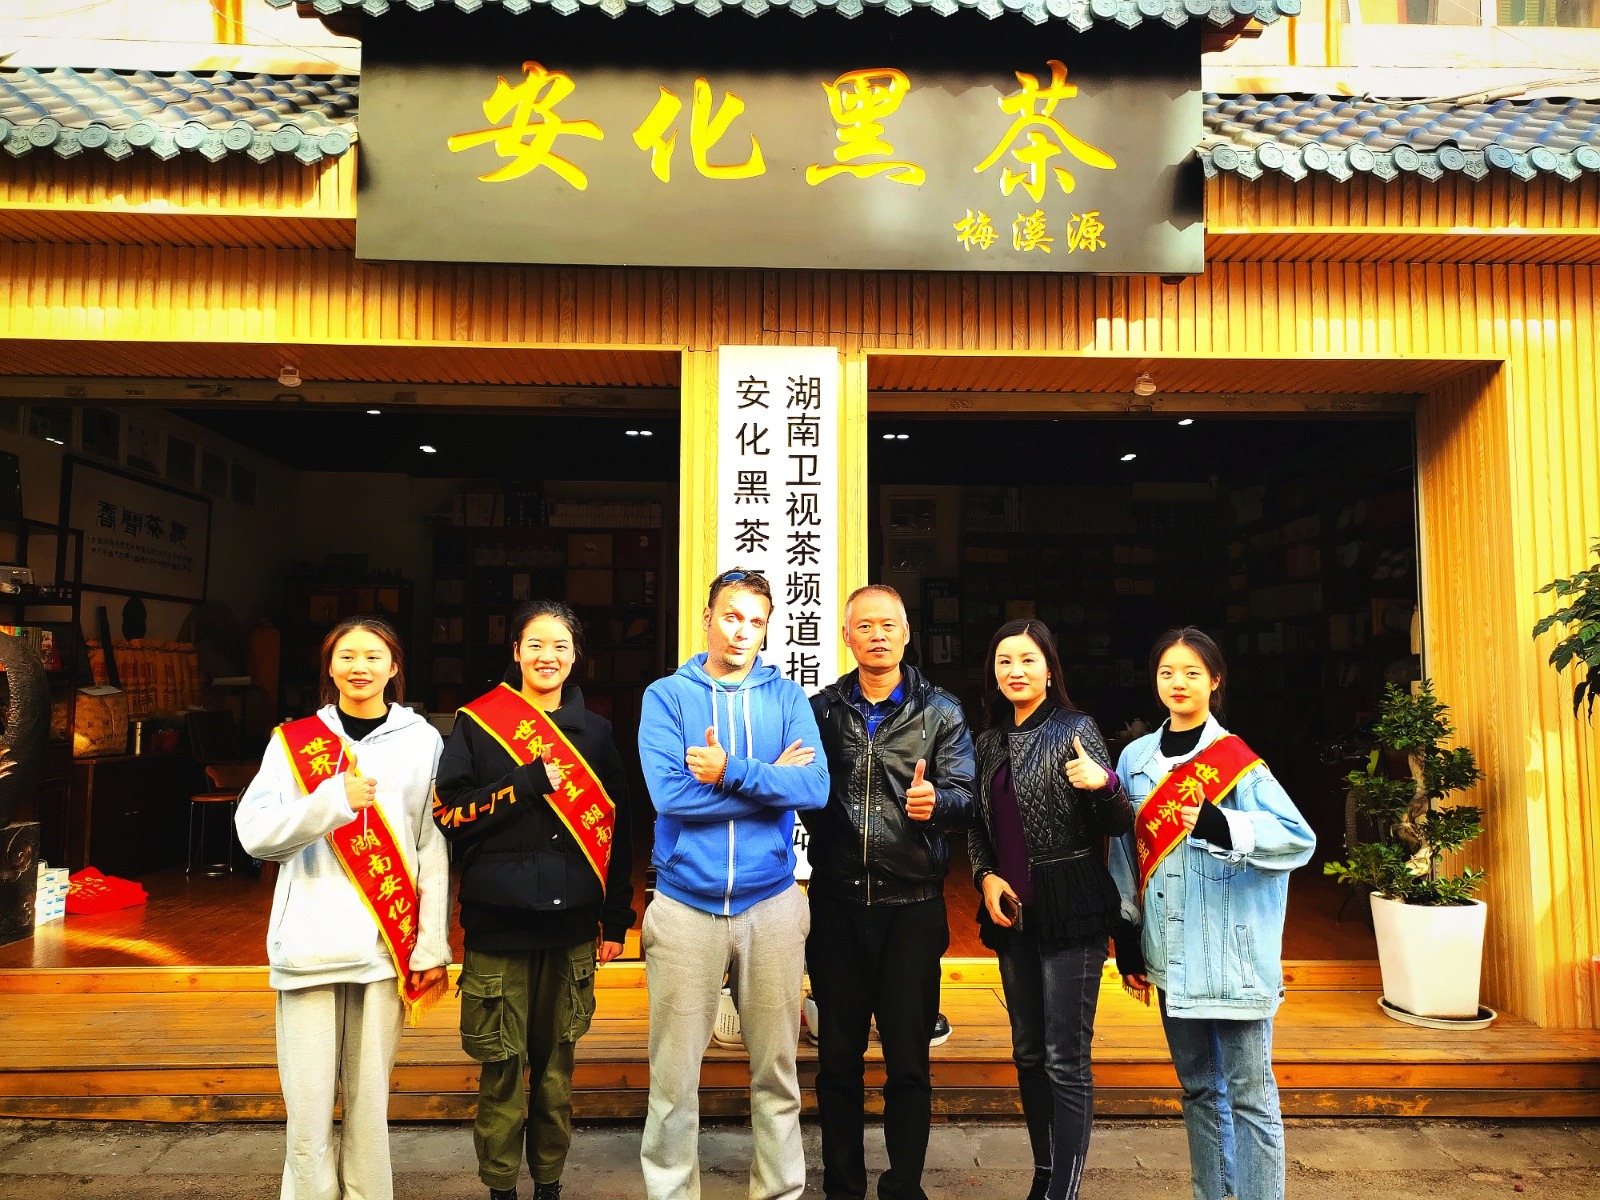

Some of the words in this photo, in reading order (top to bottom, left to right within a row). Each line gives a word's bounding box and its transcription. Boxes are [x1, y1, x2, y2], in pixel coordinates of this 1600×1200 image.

[448, 60, 1118, 204] 安化黑茶
[953, 208, 1108, 255] 梅溪源
[734, 374, 771, 652] 安化黑茶
